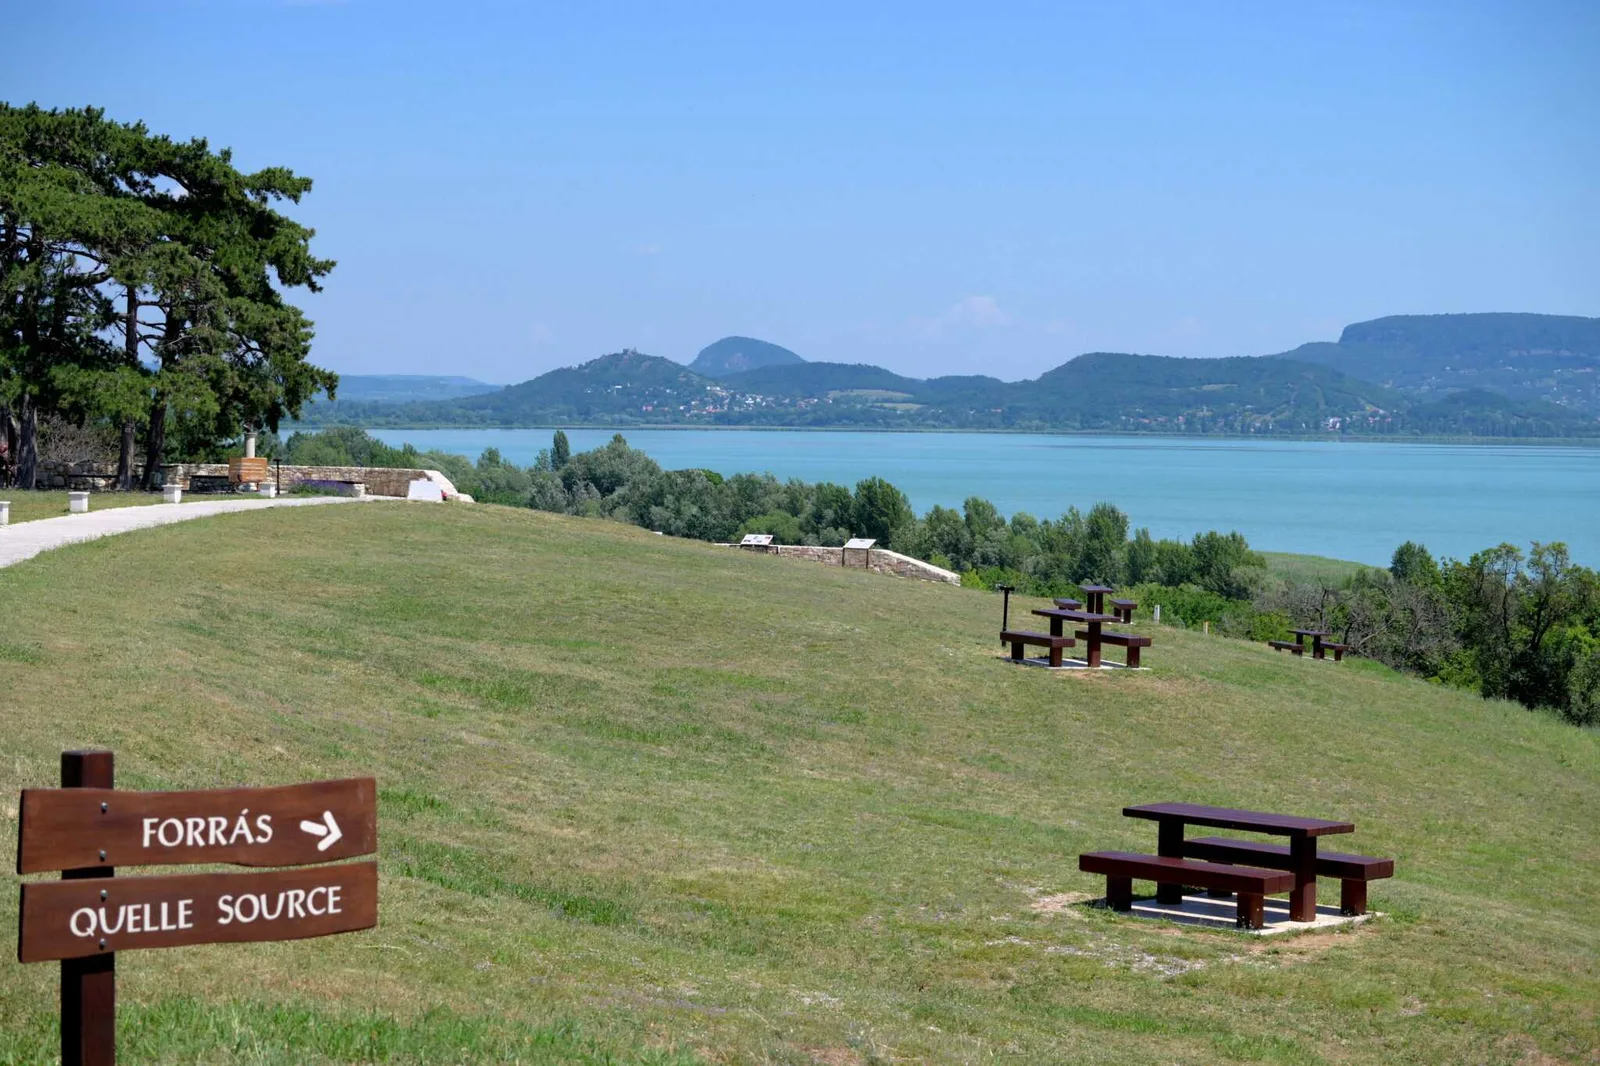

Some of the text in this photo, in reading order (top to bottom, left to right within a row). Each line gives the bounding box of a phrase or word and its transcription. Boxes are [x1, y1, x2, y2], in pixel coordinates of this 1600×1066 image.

[142, 808, 273, 848] FORRÁS
[69, 885, 342, 937] QUELLE SOURCE
